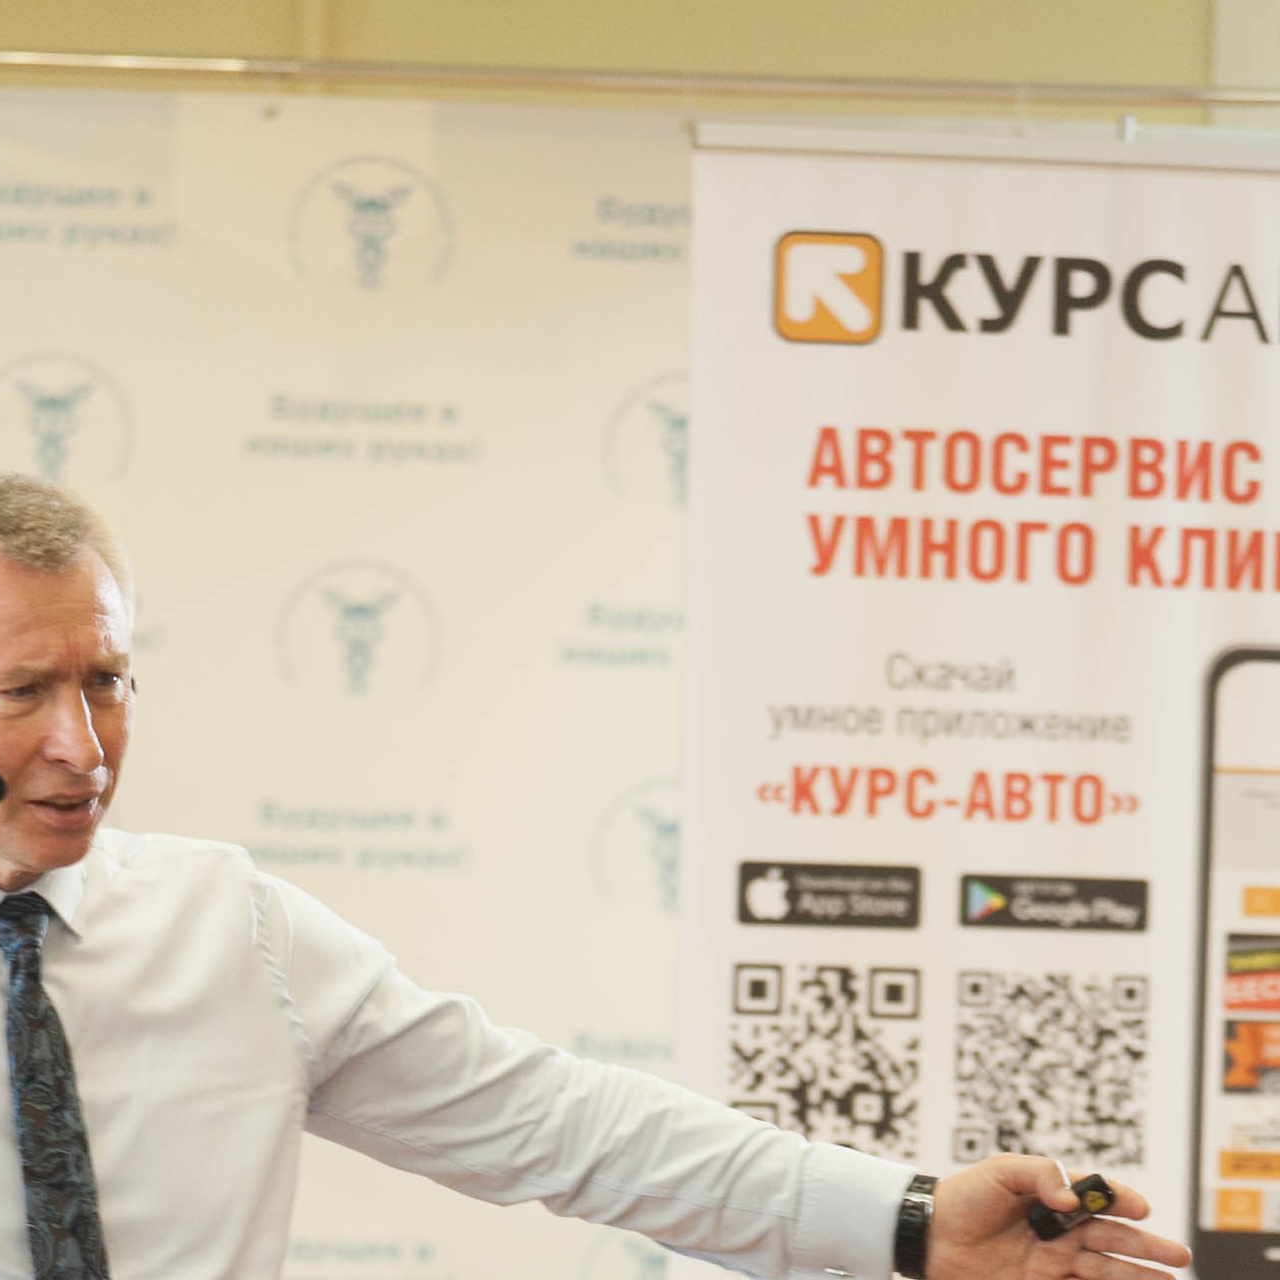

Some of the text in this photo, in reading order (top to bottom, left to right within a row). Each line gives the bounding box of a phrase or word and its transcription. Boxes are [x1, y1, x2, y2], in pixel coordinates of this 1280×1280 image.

[900, 250, 1280, 345] КУРСА
[806, 426, 1263, 505] АВТОСЕРВИС
[806, 513, 1280, 593] УМНОГО КЛИ
[886, 653, 1016, 693] Скачай
[768, 702, 1132, 745] умное приложение
[756, 764, 1139, 826] «КУРС-АВТО»
